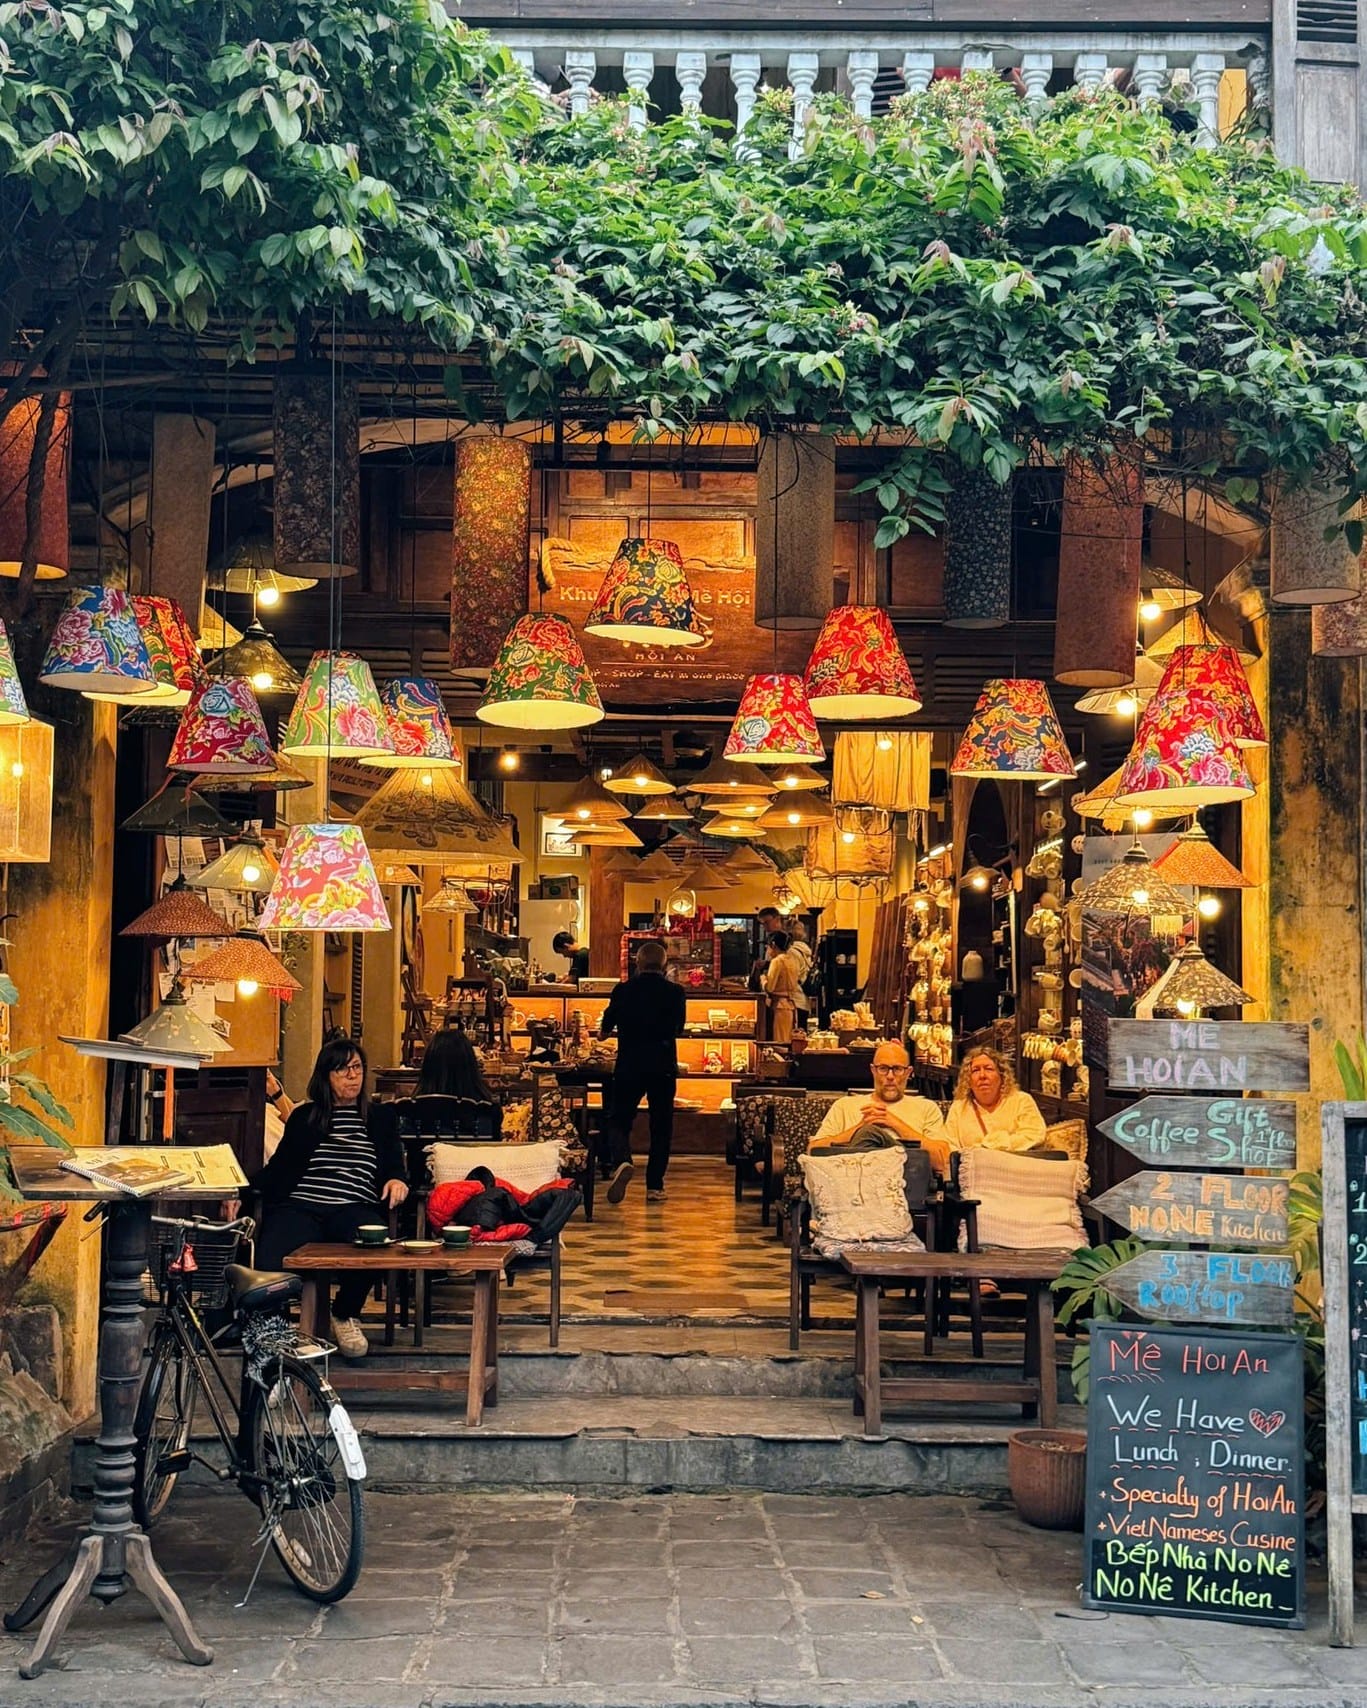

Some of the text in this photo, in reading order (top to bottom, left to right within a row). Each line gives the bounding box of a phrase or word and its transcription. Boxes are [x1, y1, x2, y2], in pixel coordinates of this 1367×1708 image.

[717, 588, 751, 608] Hội
[673, 652, 696, 662] AN
[611, 669, 644, 678] SHOP
[653, 670, 676, 679] EAT
[715, 673, 745, 681] place
[1170, 1022, 1220, 1050] ME
[1114, 1100, 1270, 1154] Coffee Gift
[1207, 1127, 1279, 1167] Shop
[1201, 1175, 1289, 1217] FLOOR
[1138, 1279, 1244, 1319] Rooftop
[1109, 1339, 1161, 1372] Mê
[1107, 1394, 1245, 1433] We Have
[1115, 1434, 1179, 1464] Lunch
[1110, 1475, 1200, 1519] Specialty
[1207, 1485, 1228, 1518] of
[1230, 1520, 1297, 1552] Cusine
[1186, 1573, 1275, 1611] Kitchen
